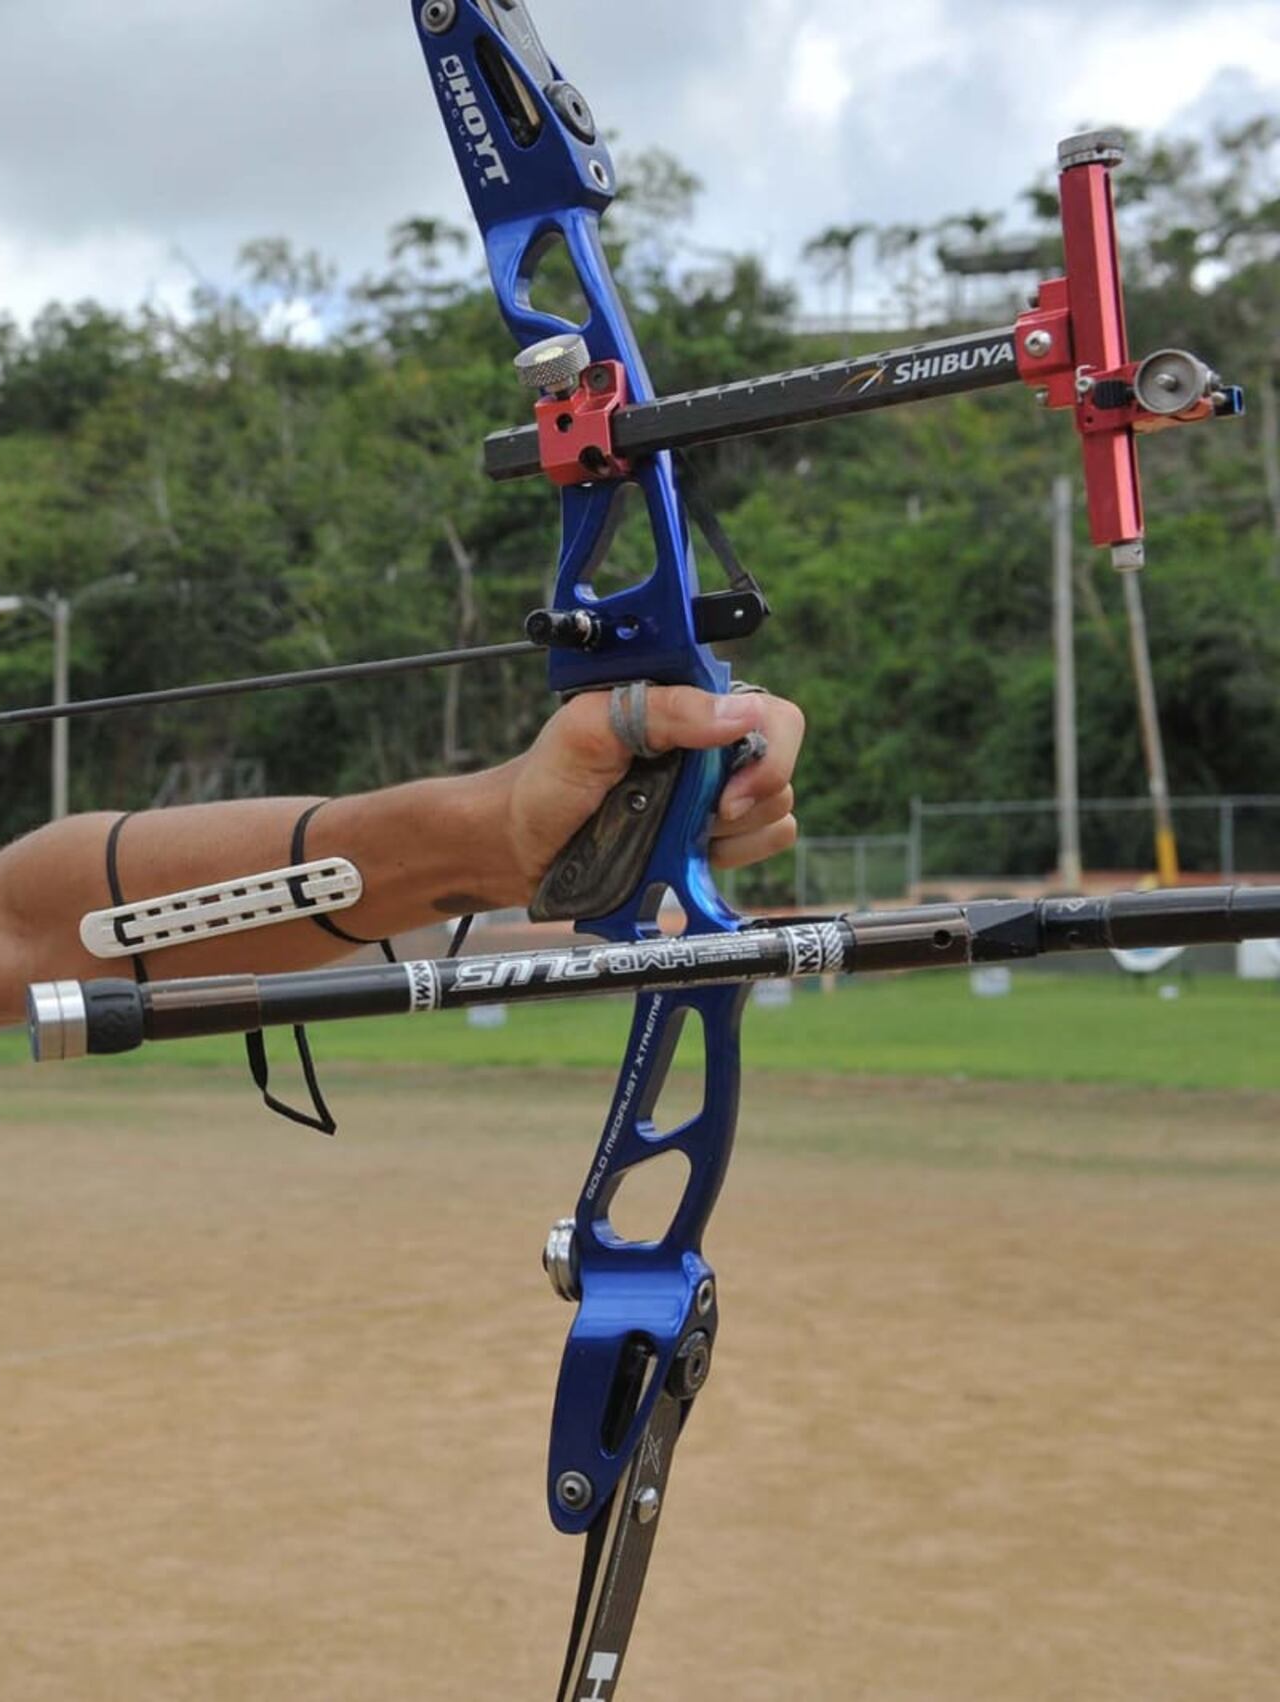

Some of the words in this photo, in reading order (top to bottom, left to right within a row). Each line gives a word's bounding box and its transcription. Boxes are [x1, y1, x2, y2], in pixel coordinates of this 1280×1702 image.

[447, 74, 510, 185] HOYT
[893, 342, 1014, 384] SHIBUYA
[448, 949, 601, 992] PLUS
[585, 1156, 608, 1200] GOLD
[605, 1072, 639, 1155] MEDALIST
[635, 993, 662, 1068] XTREME
